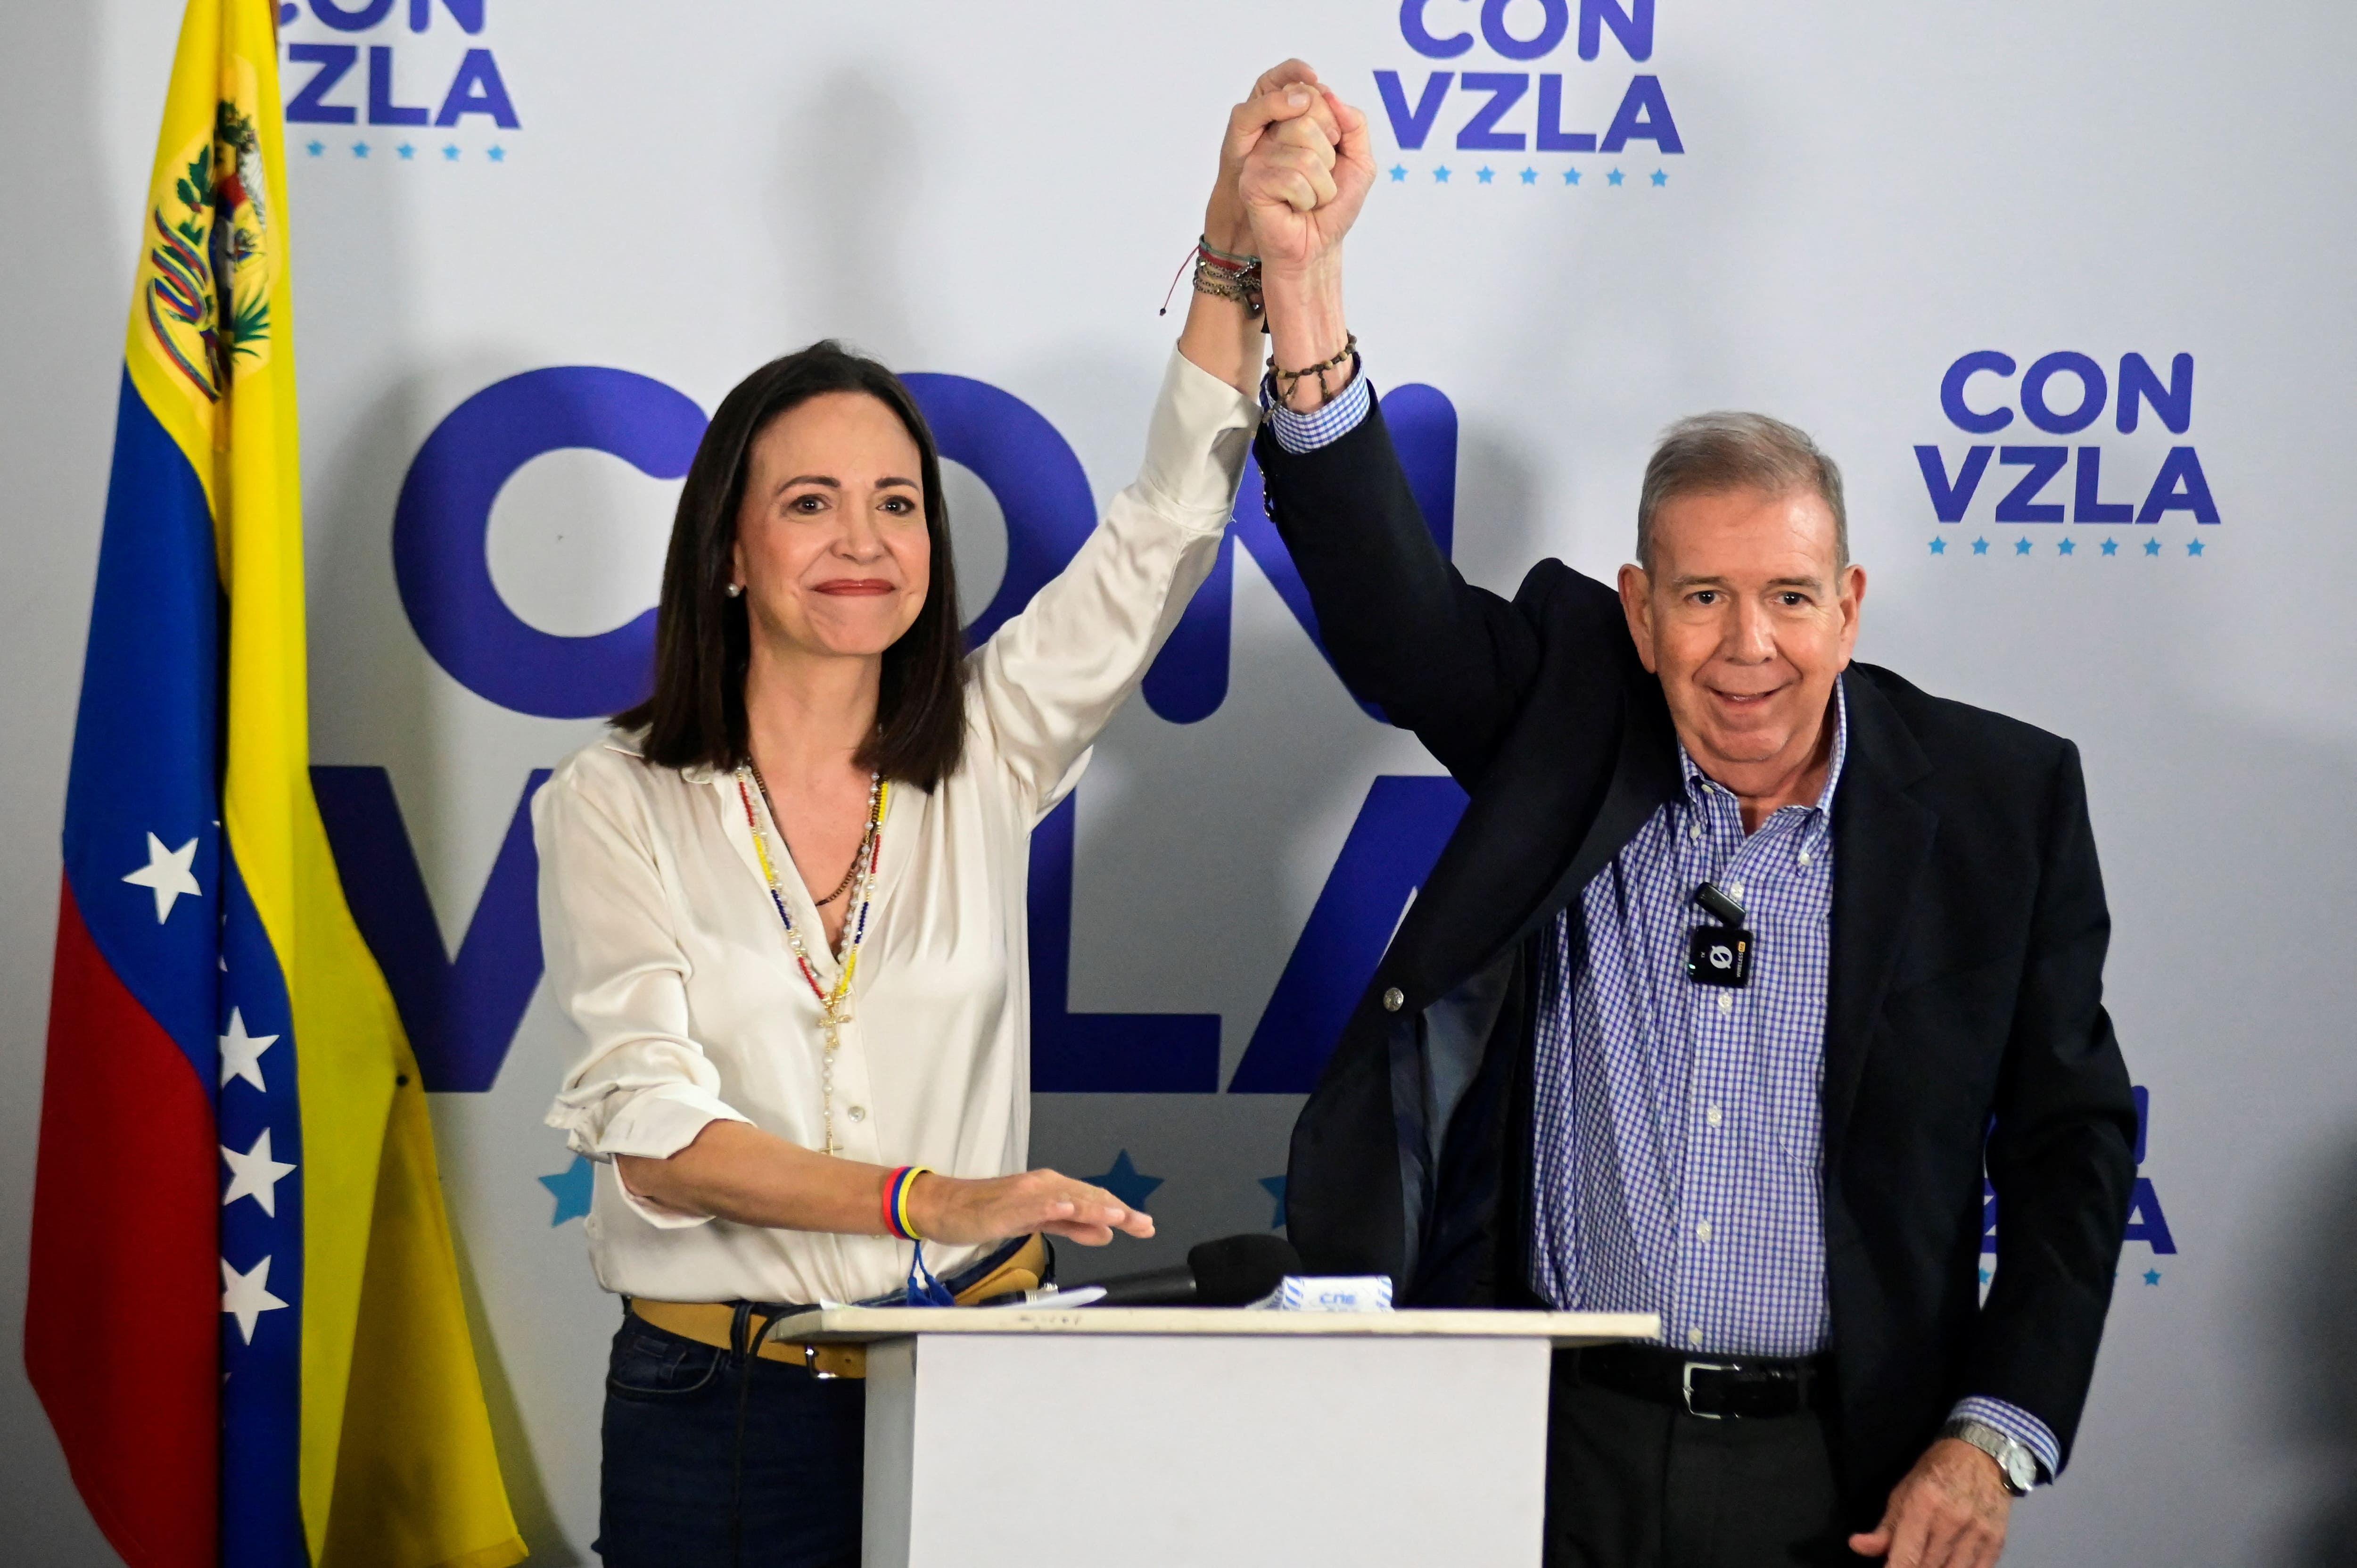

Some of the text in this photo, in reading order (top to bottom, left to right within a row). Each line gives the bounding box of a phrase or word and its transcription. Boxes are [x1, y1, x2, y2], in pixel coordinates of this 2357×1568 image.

[1400, 0, 1655, 62] CON
[286, 43, 522, 130] ZLA
[1373, 70, 1685, 154] VZLA
[1940, 350, 2194, 435] CON
[1913, 445, 2221, 524] VZLA
[308, 766, 1472, 1094] VLA
